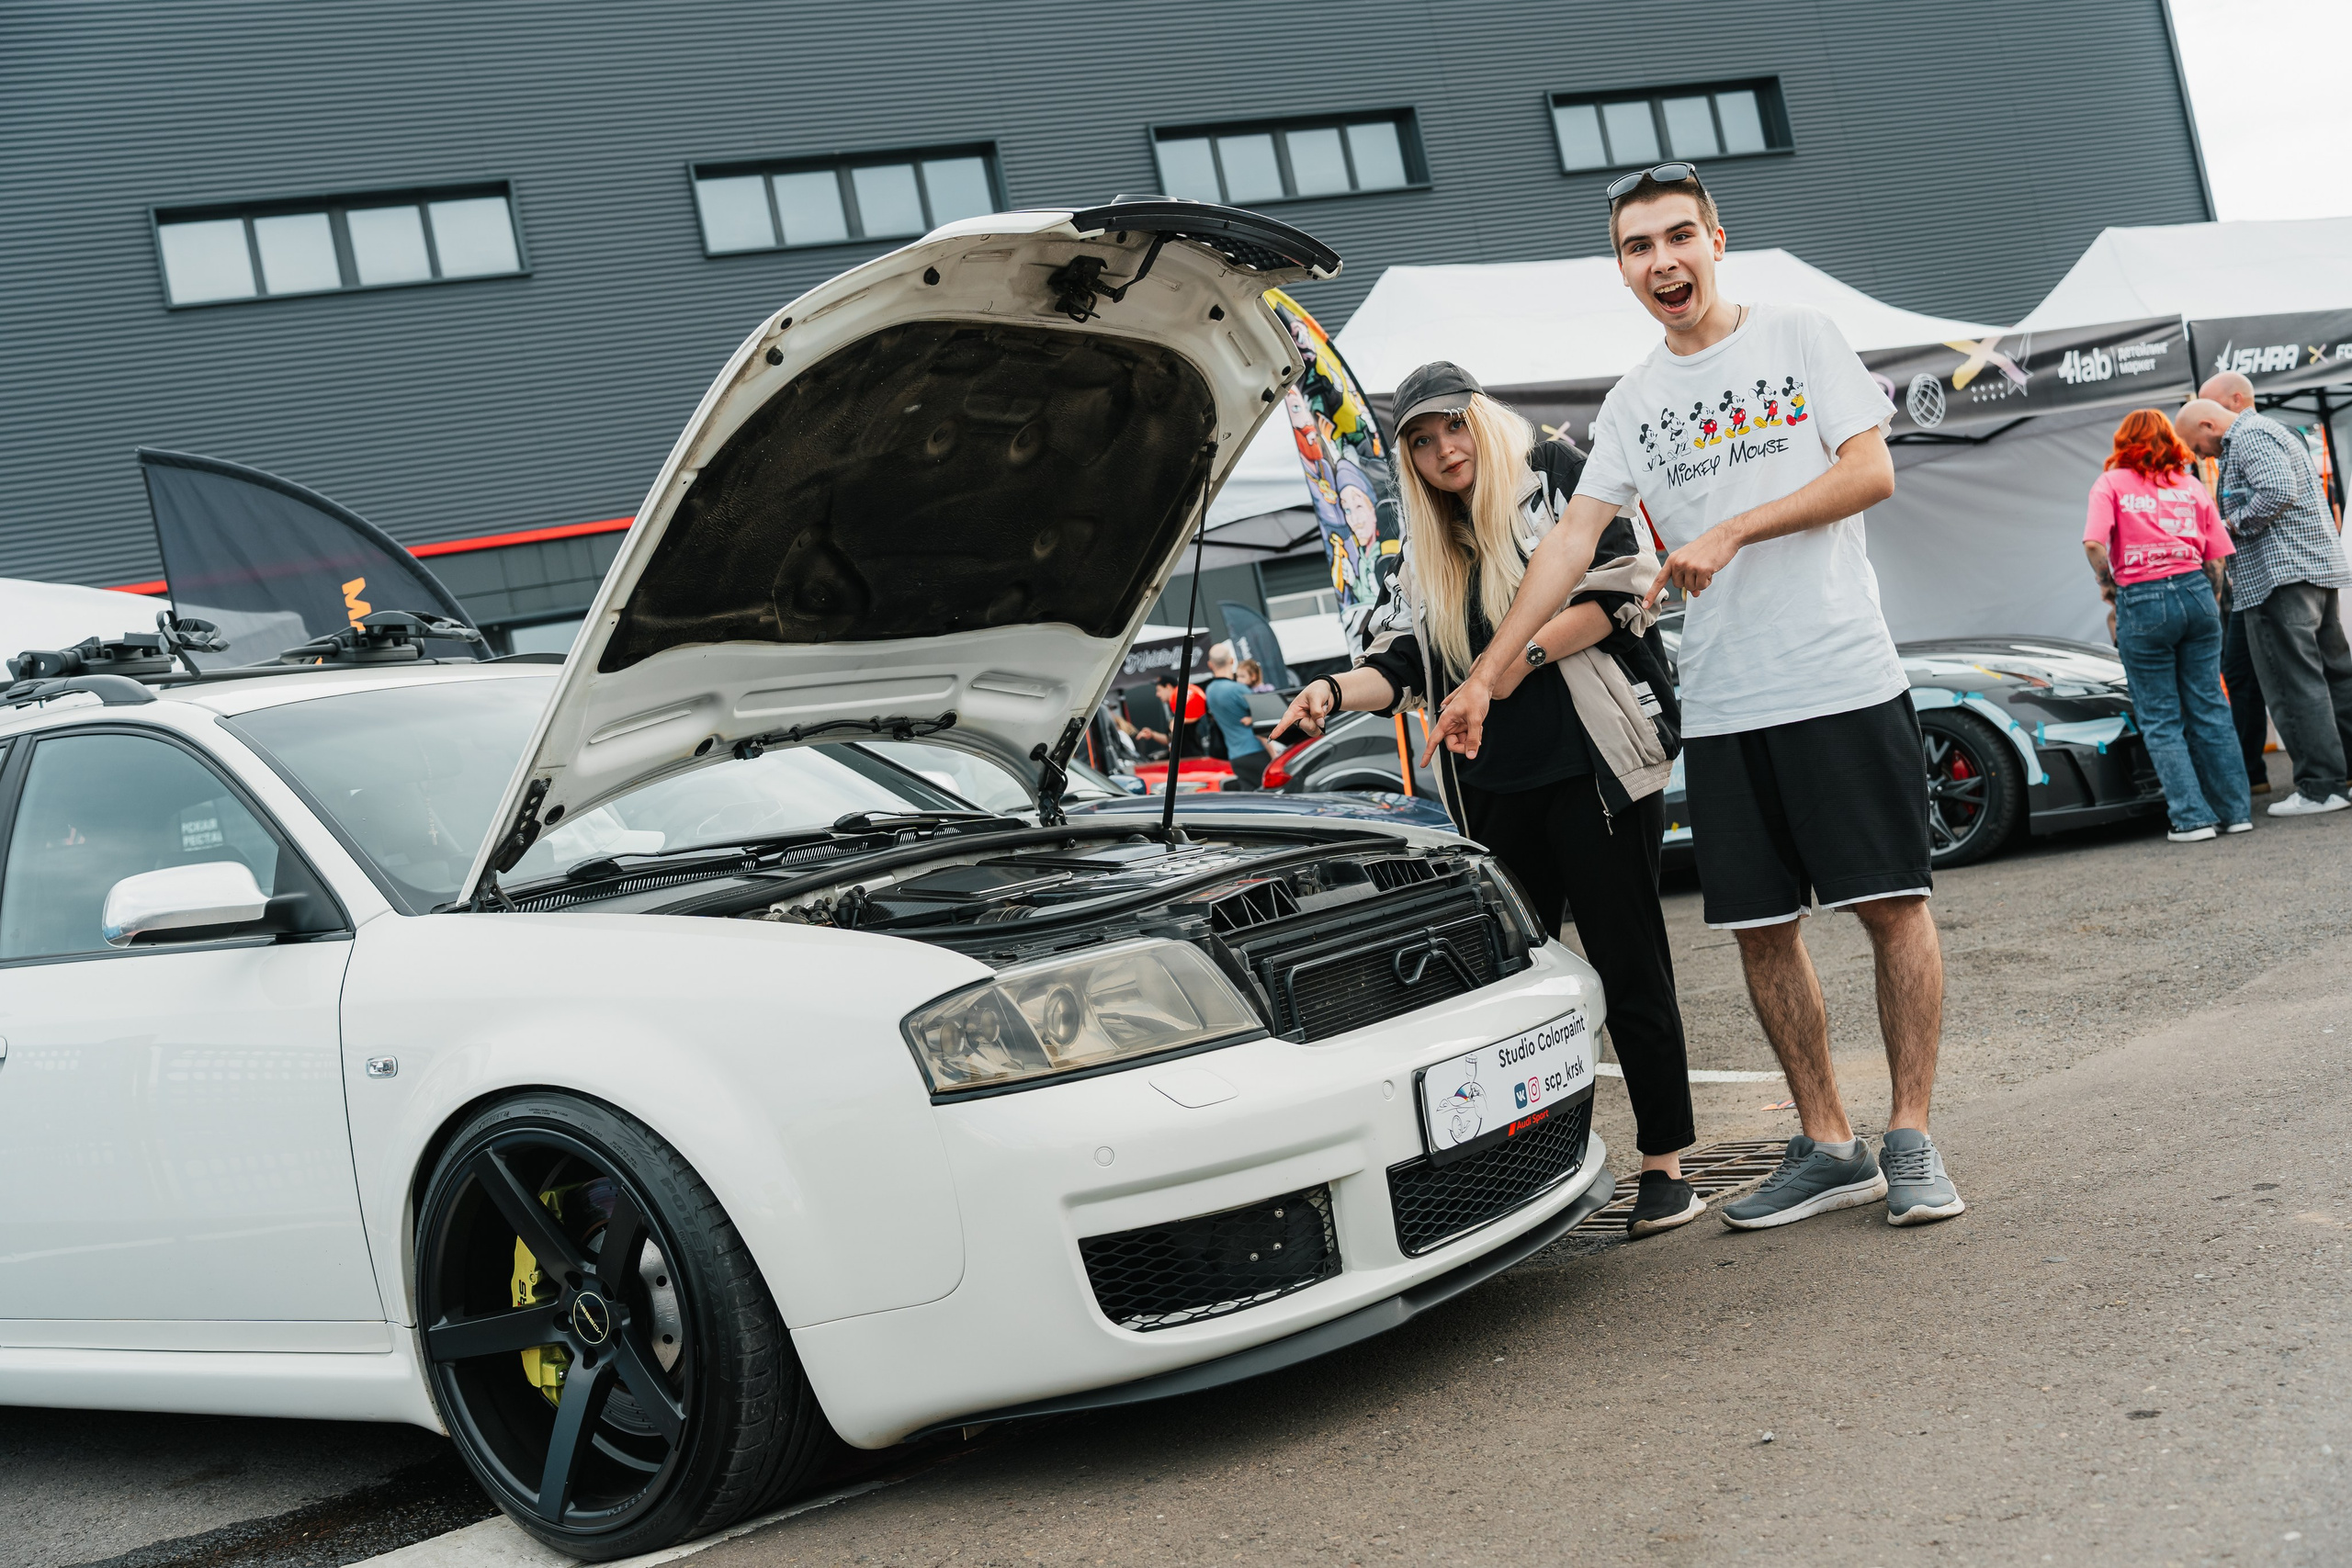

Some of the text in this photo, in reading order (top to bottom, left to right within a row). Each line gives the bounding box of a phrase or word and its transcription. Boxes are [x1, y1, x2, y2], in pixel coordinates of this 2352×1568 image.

[2117, 342, 2168, 362] детейлинг
[2057, 347, 2113, 384] 4lab
[2119, 358, 2156, 376] маркет
[2120, 493, 2156, 511] 4lab
[1498, 1014, 1586, 1068] Studio Colorpaint
[1544, 1055, 1585, 1092] scp_krsk
[1516, 1109, 1549, 1130] Audi Sport
